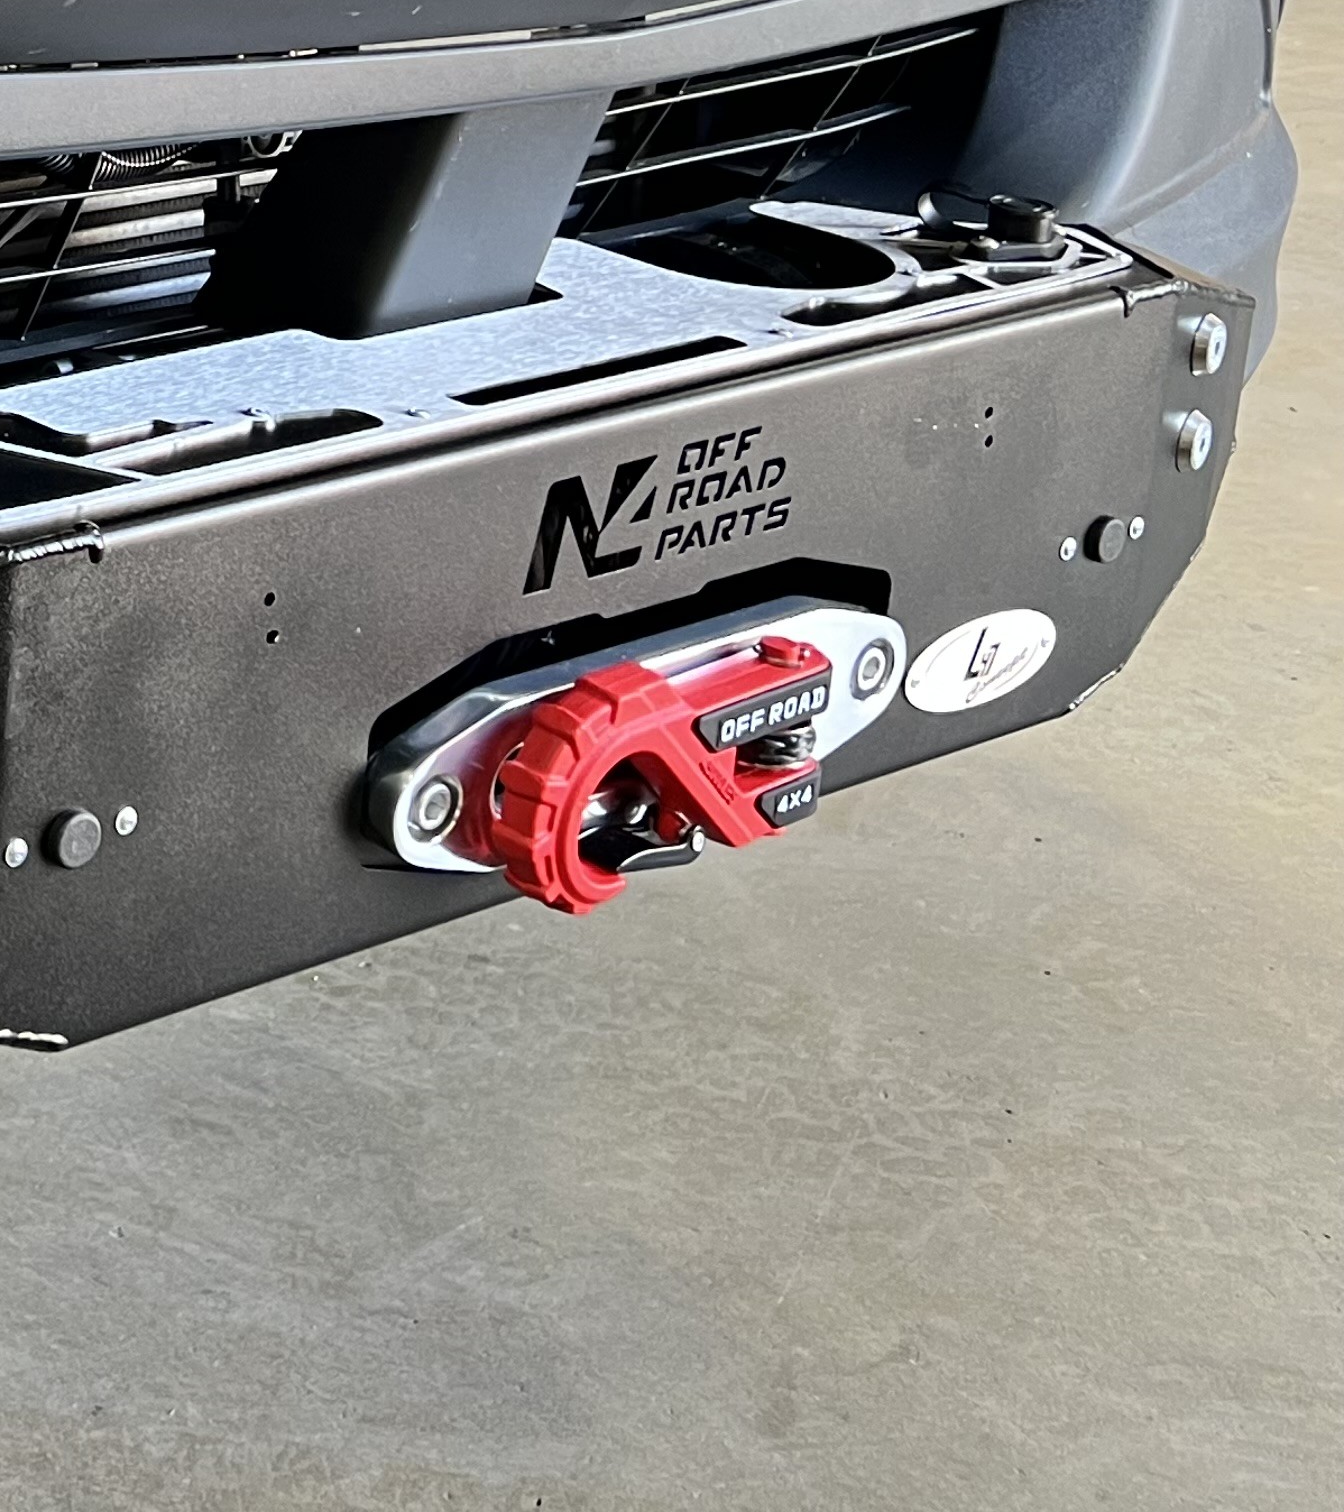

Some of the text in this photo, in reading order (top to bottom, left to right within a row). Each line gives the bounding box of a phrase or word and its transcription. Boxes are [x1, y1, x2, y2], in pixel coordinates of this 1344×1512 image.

[677, 426, 762, 475] OFF
[666, 457, 787, 514] ROAD
[655, 496, 792, 561] PARTS
[720, 685, 826, 743] OFF ROAD
